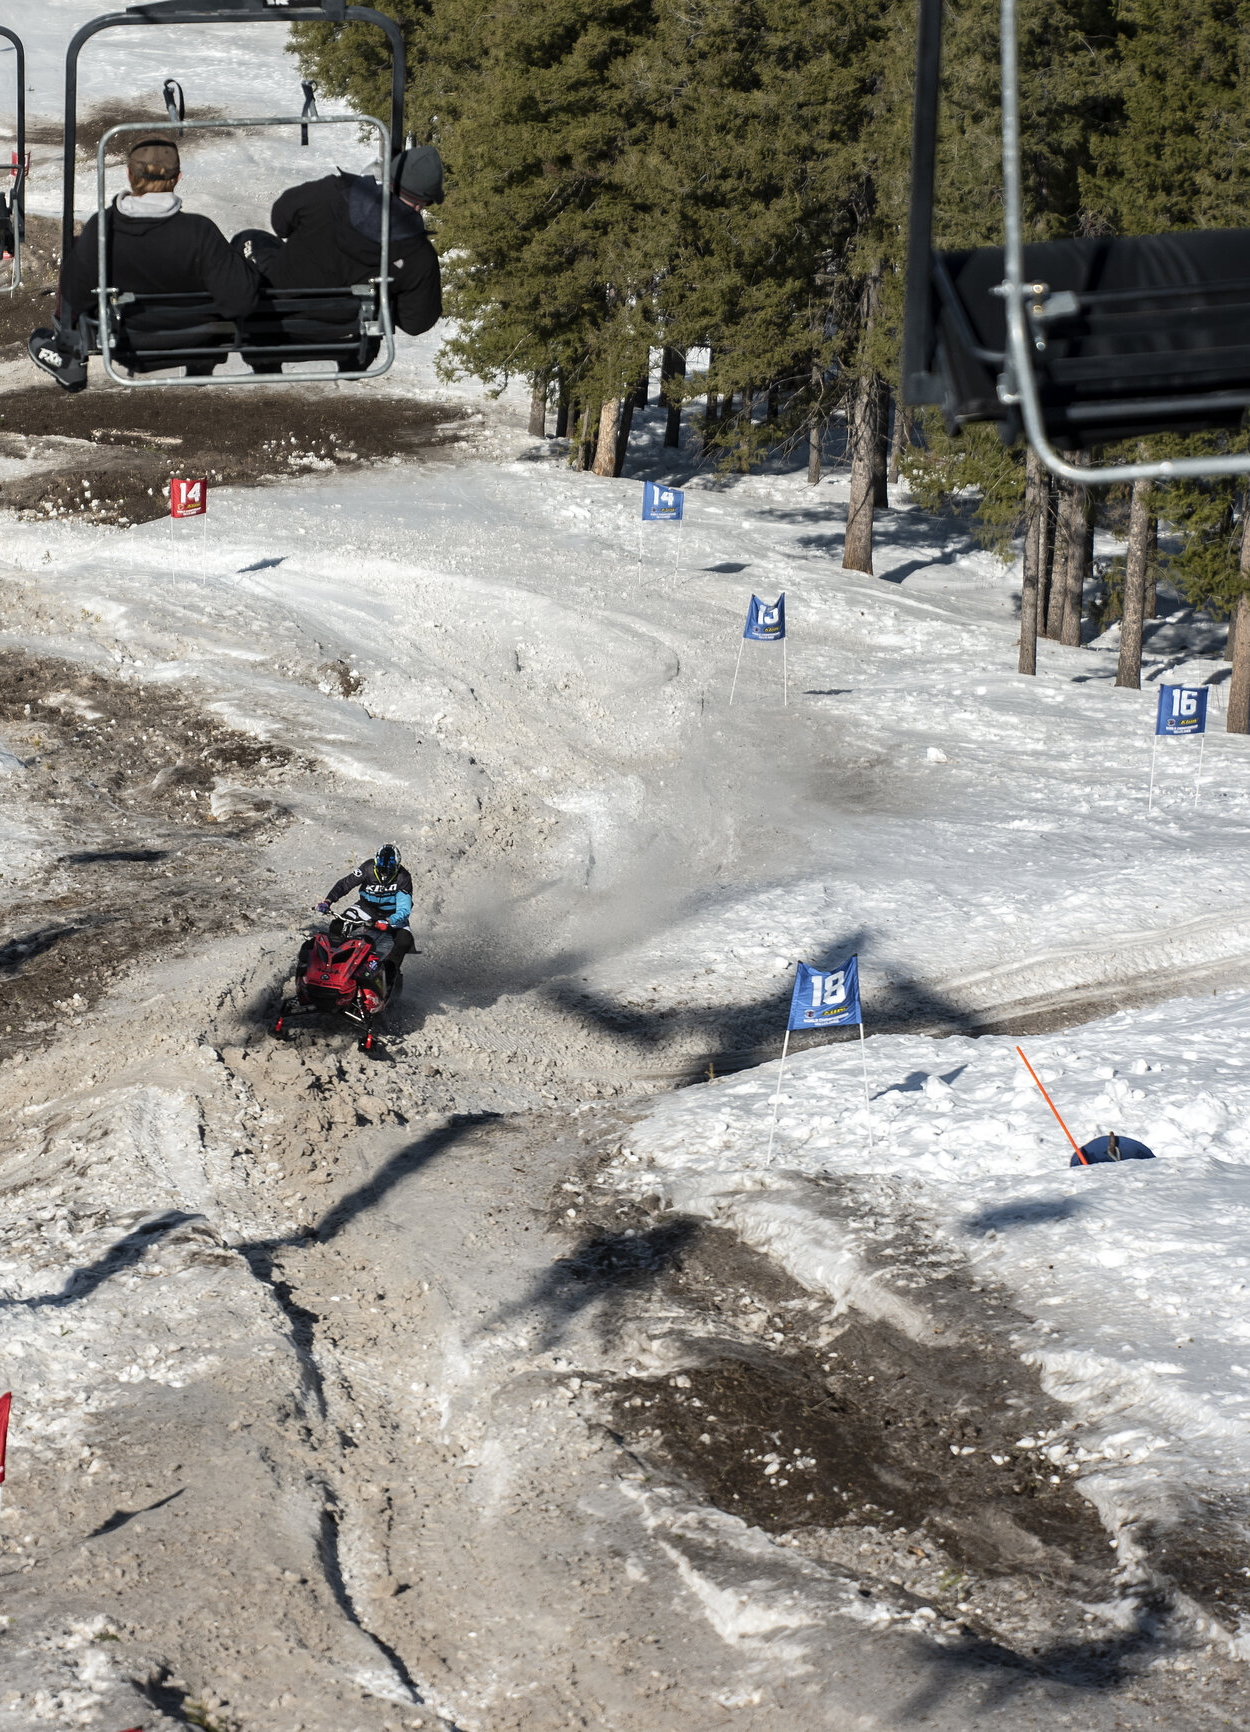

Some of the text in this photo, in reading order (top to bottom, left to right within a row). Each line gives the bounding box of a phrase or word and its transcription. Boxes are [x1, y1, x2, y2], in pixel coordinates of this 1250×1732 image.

[179, 482, 201, 504] 14
[652, 485, 674, 506] 14
[1172, 688, 1198, 716] 16
[811, 970, 847, 1007] 18
